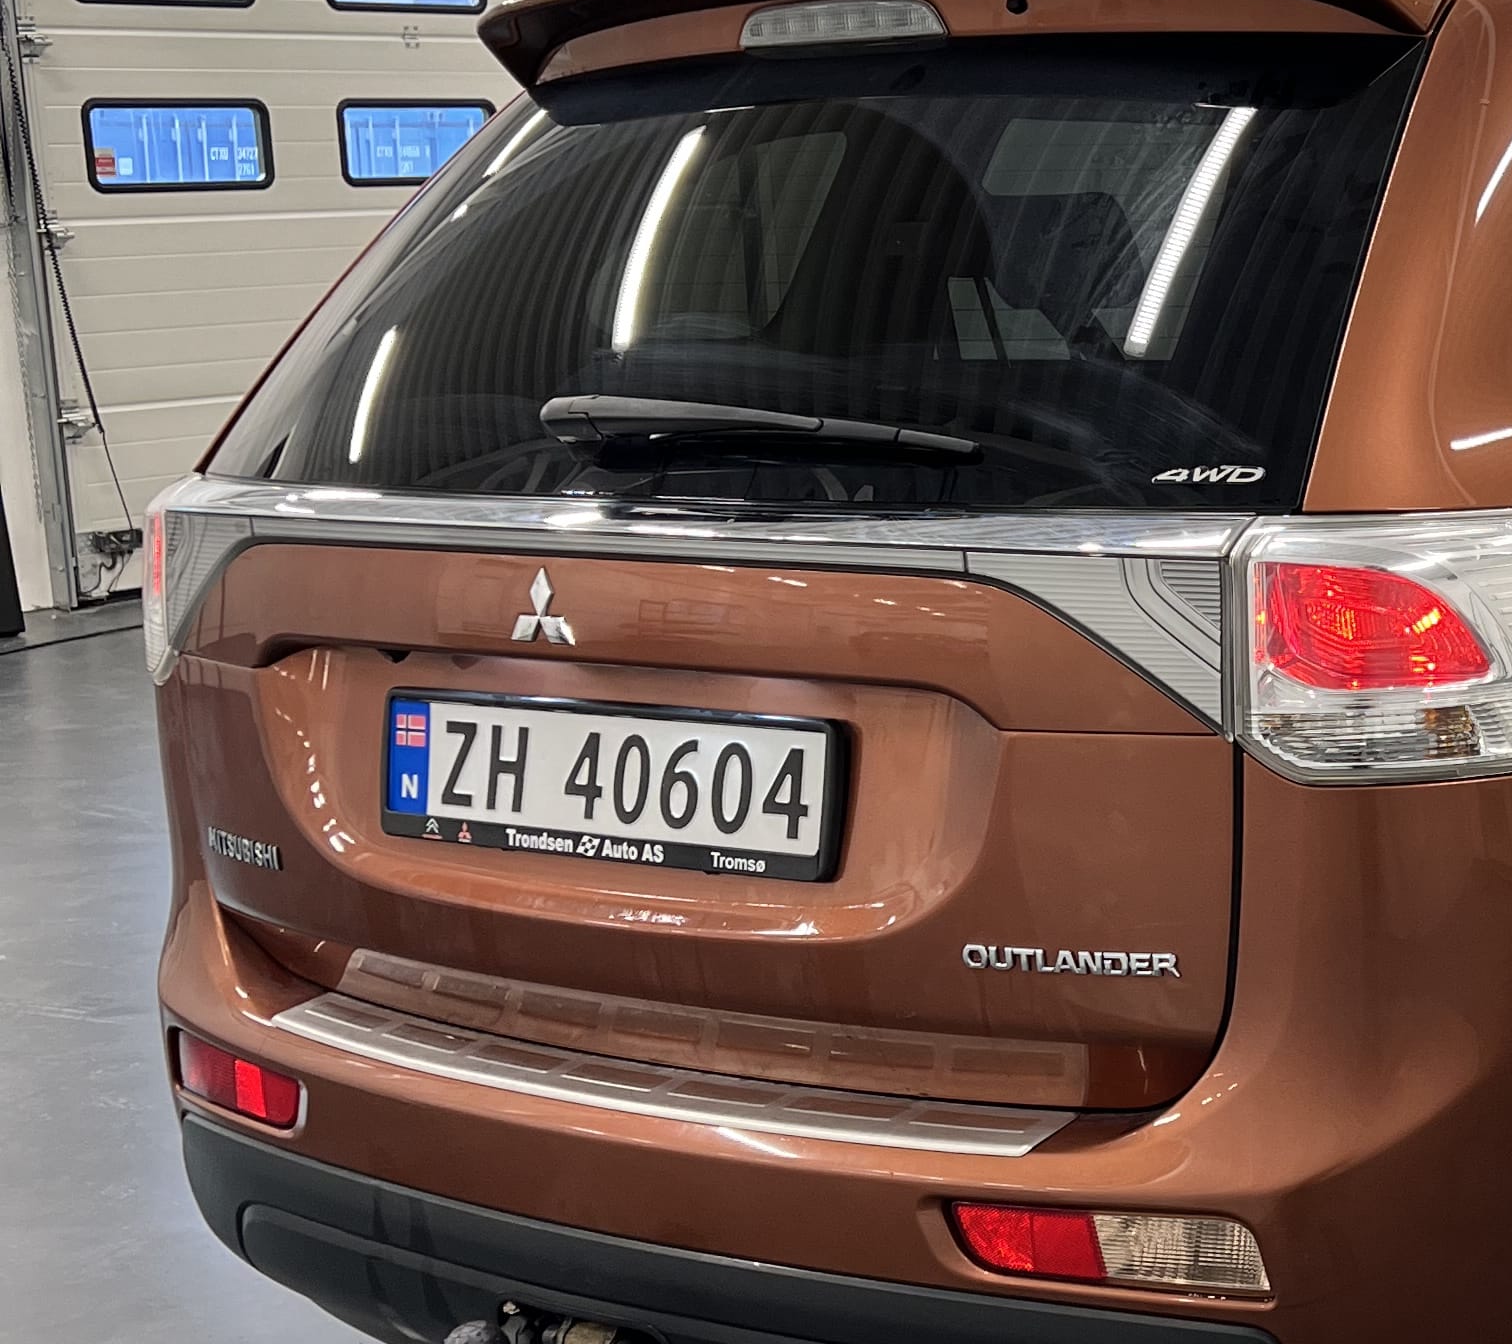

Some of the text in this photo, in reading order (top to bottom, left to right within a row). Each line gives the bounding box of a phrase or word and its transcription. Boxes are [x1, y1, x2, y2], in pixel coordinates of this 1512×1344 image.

[401, 773, 419, 800] N
[441, 720, 809, 840] ZH 40604
[208, 826, 280, 871] MITSUBISHI
[505, 828, 665, 864] Trondsen Auto AS
[710, 851, 766, 873] Tromsø
[962, 943, 1182, 978] OUTLANDER
